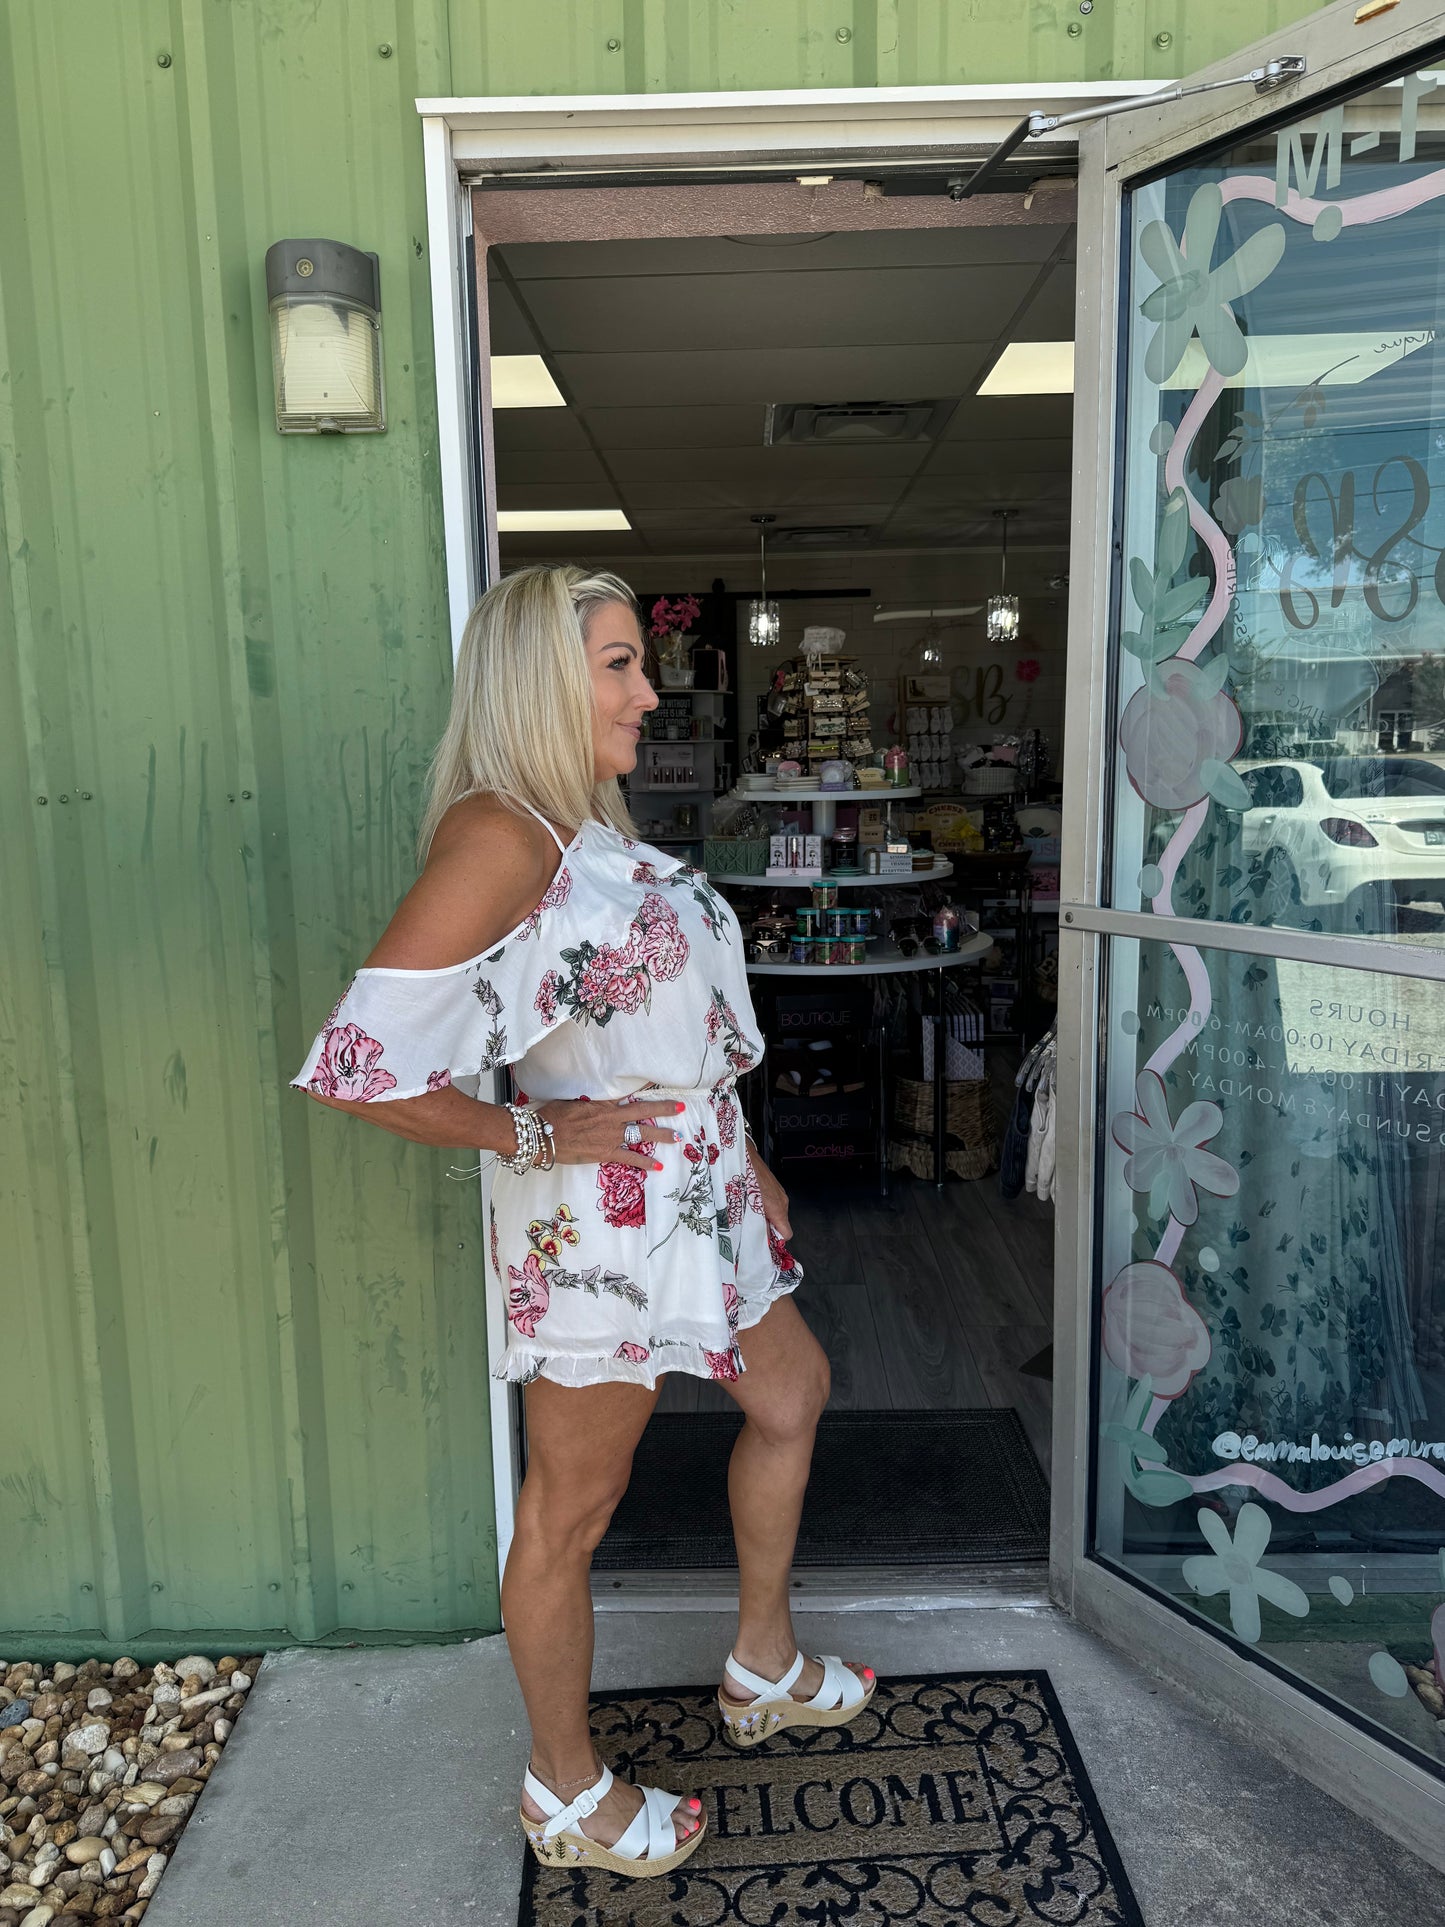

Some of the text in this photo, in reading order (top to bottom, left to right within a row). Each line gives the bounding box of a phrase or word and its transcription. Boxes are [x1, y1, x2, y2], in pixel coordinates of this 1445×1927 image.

[781, 1010, 851, 1027] BOUTIQUE
[779, 1113, 848, 1129] BOUTIQUE
[804, 1143, 855, 1157] Corkys
[693, 1770, 990, 1838] ELCOME
